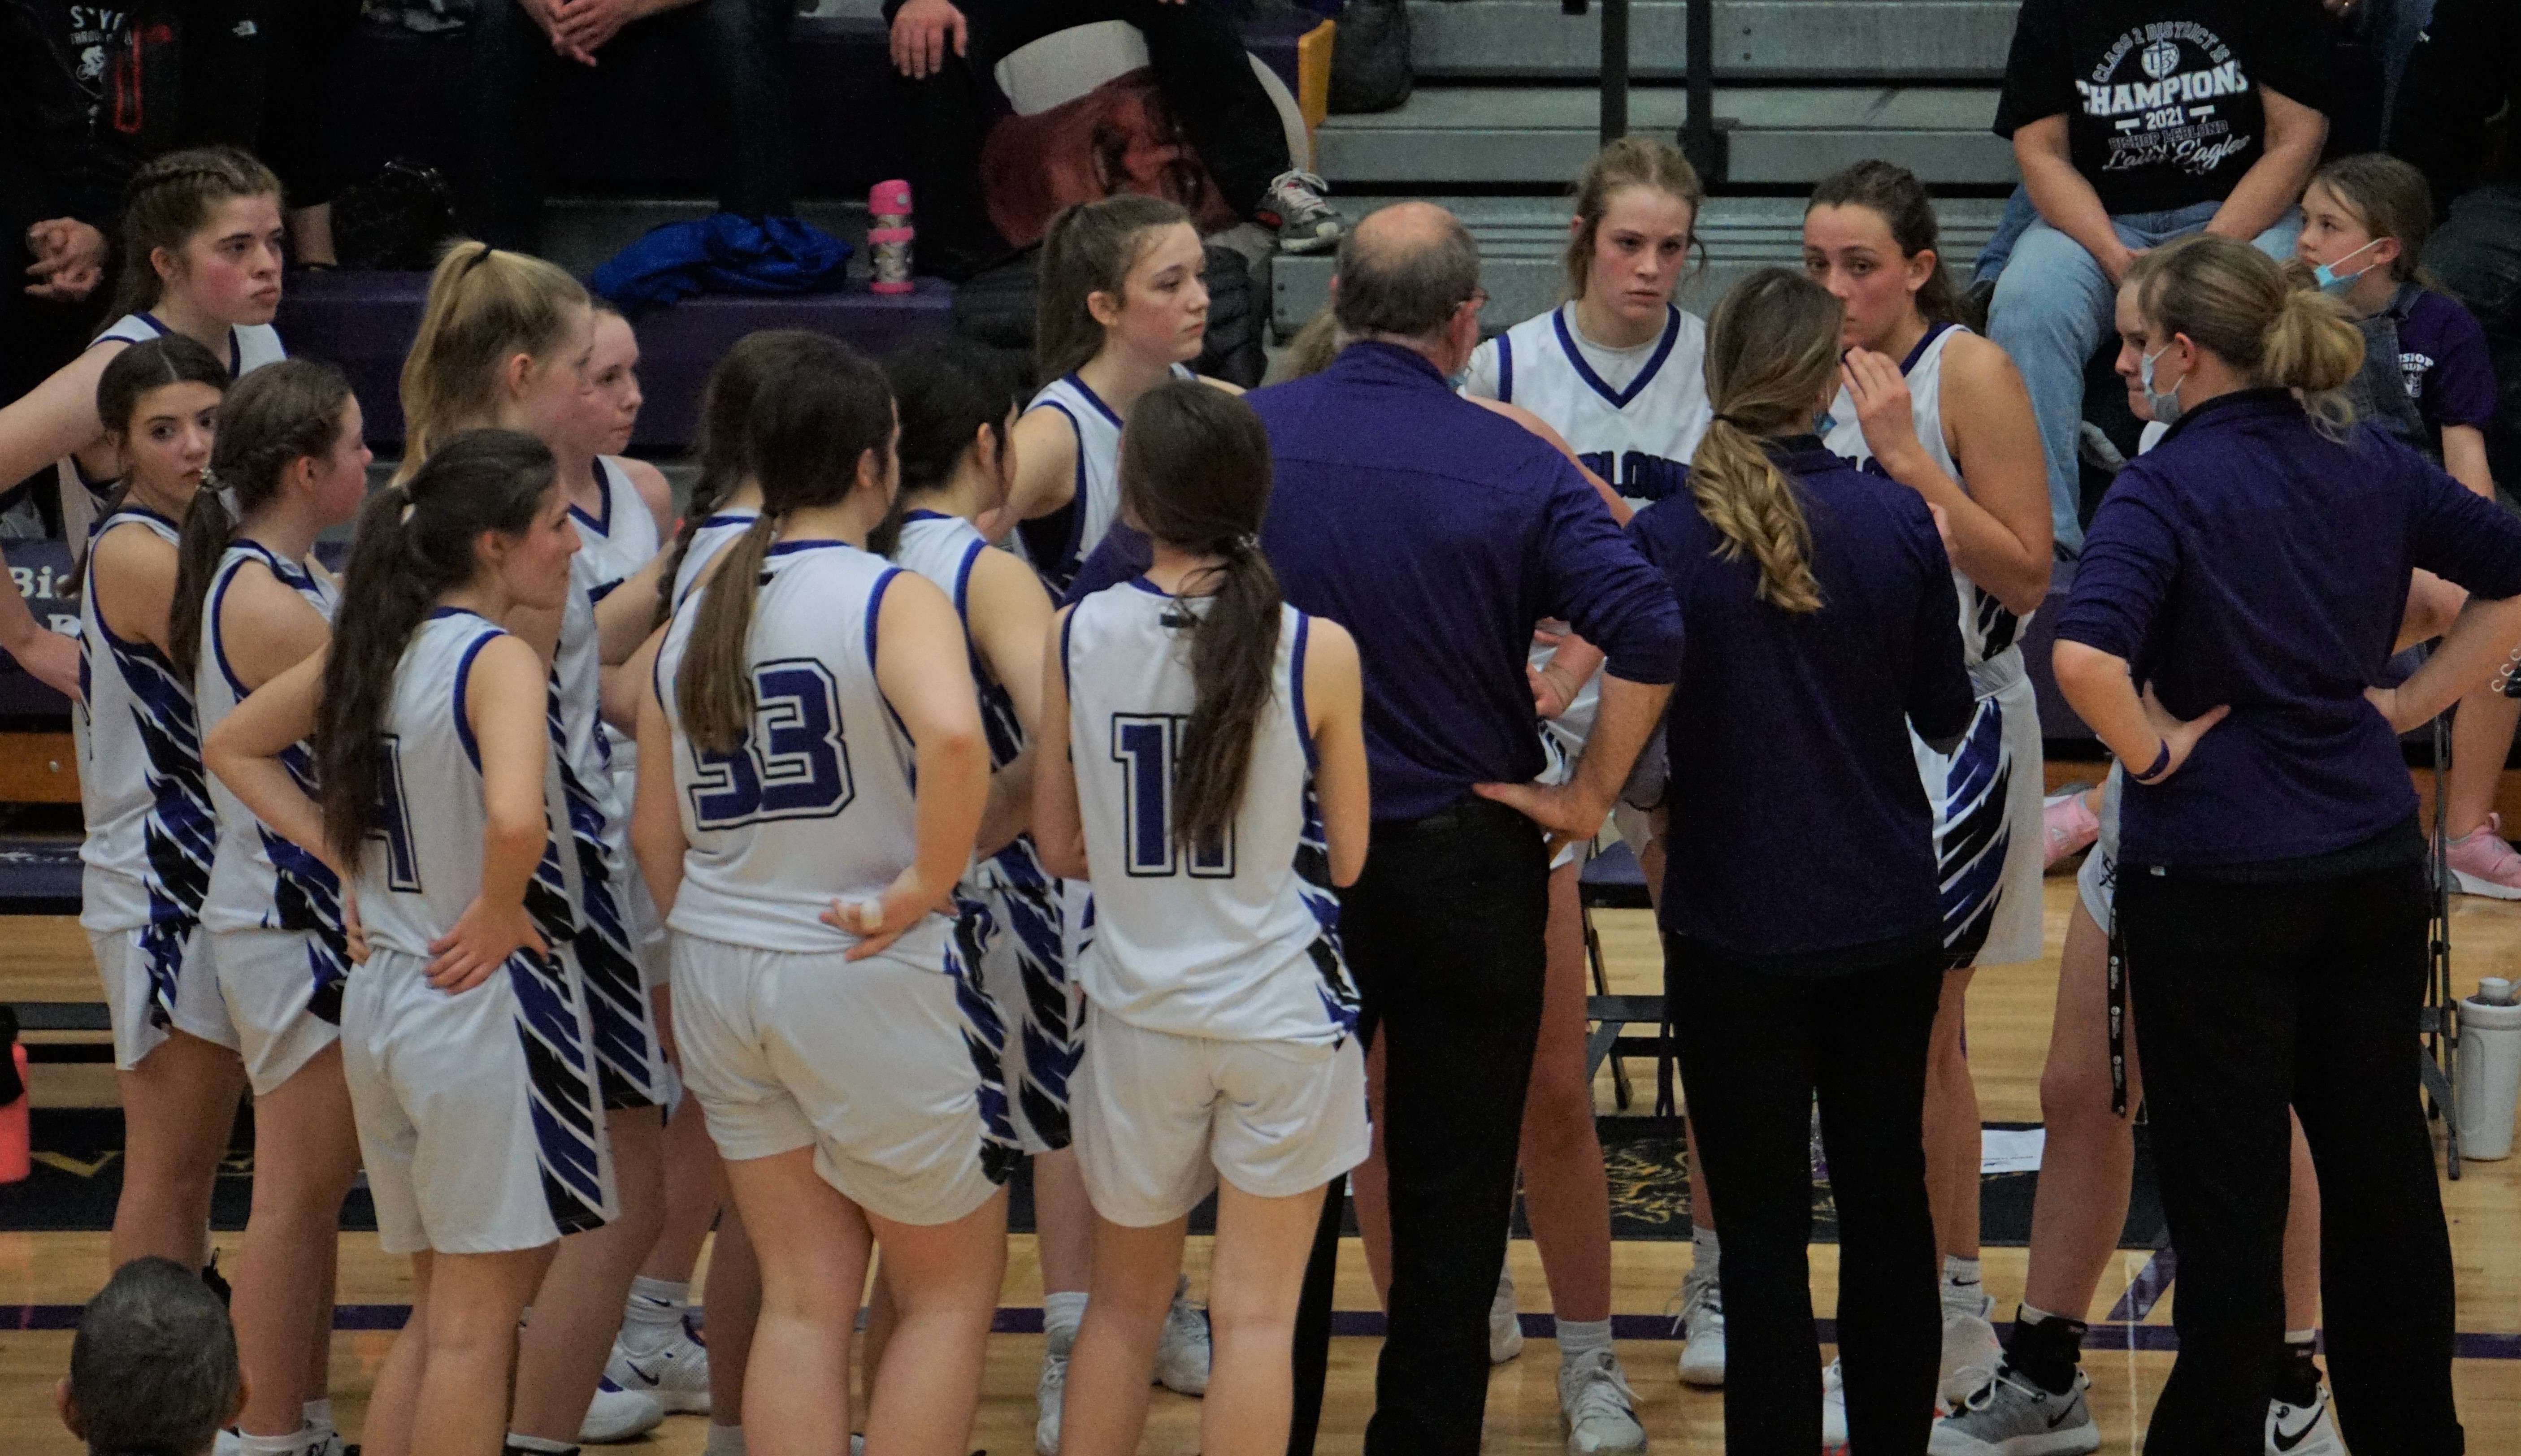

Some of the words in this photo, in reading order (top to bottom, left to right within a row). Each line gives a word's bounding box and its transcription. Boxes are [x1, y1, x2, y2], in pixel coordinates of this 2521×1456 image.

[2092, 32, 2133, 82] CLASS
[2131, 27, 2145, 44] 2
[2145, 21, 2219, 49] DISTRICT
[2146, 106, 2185, 130] 2021
